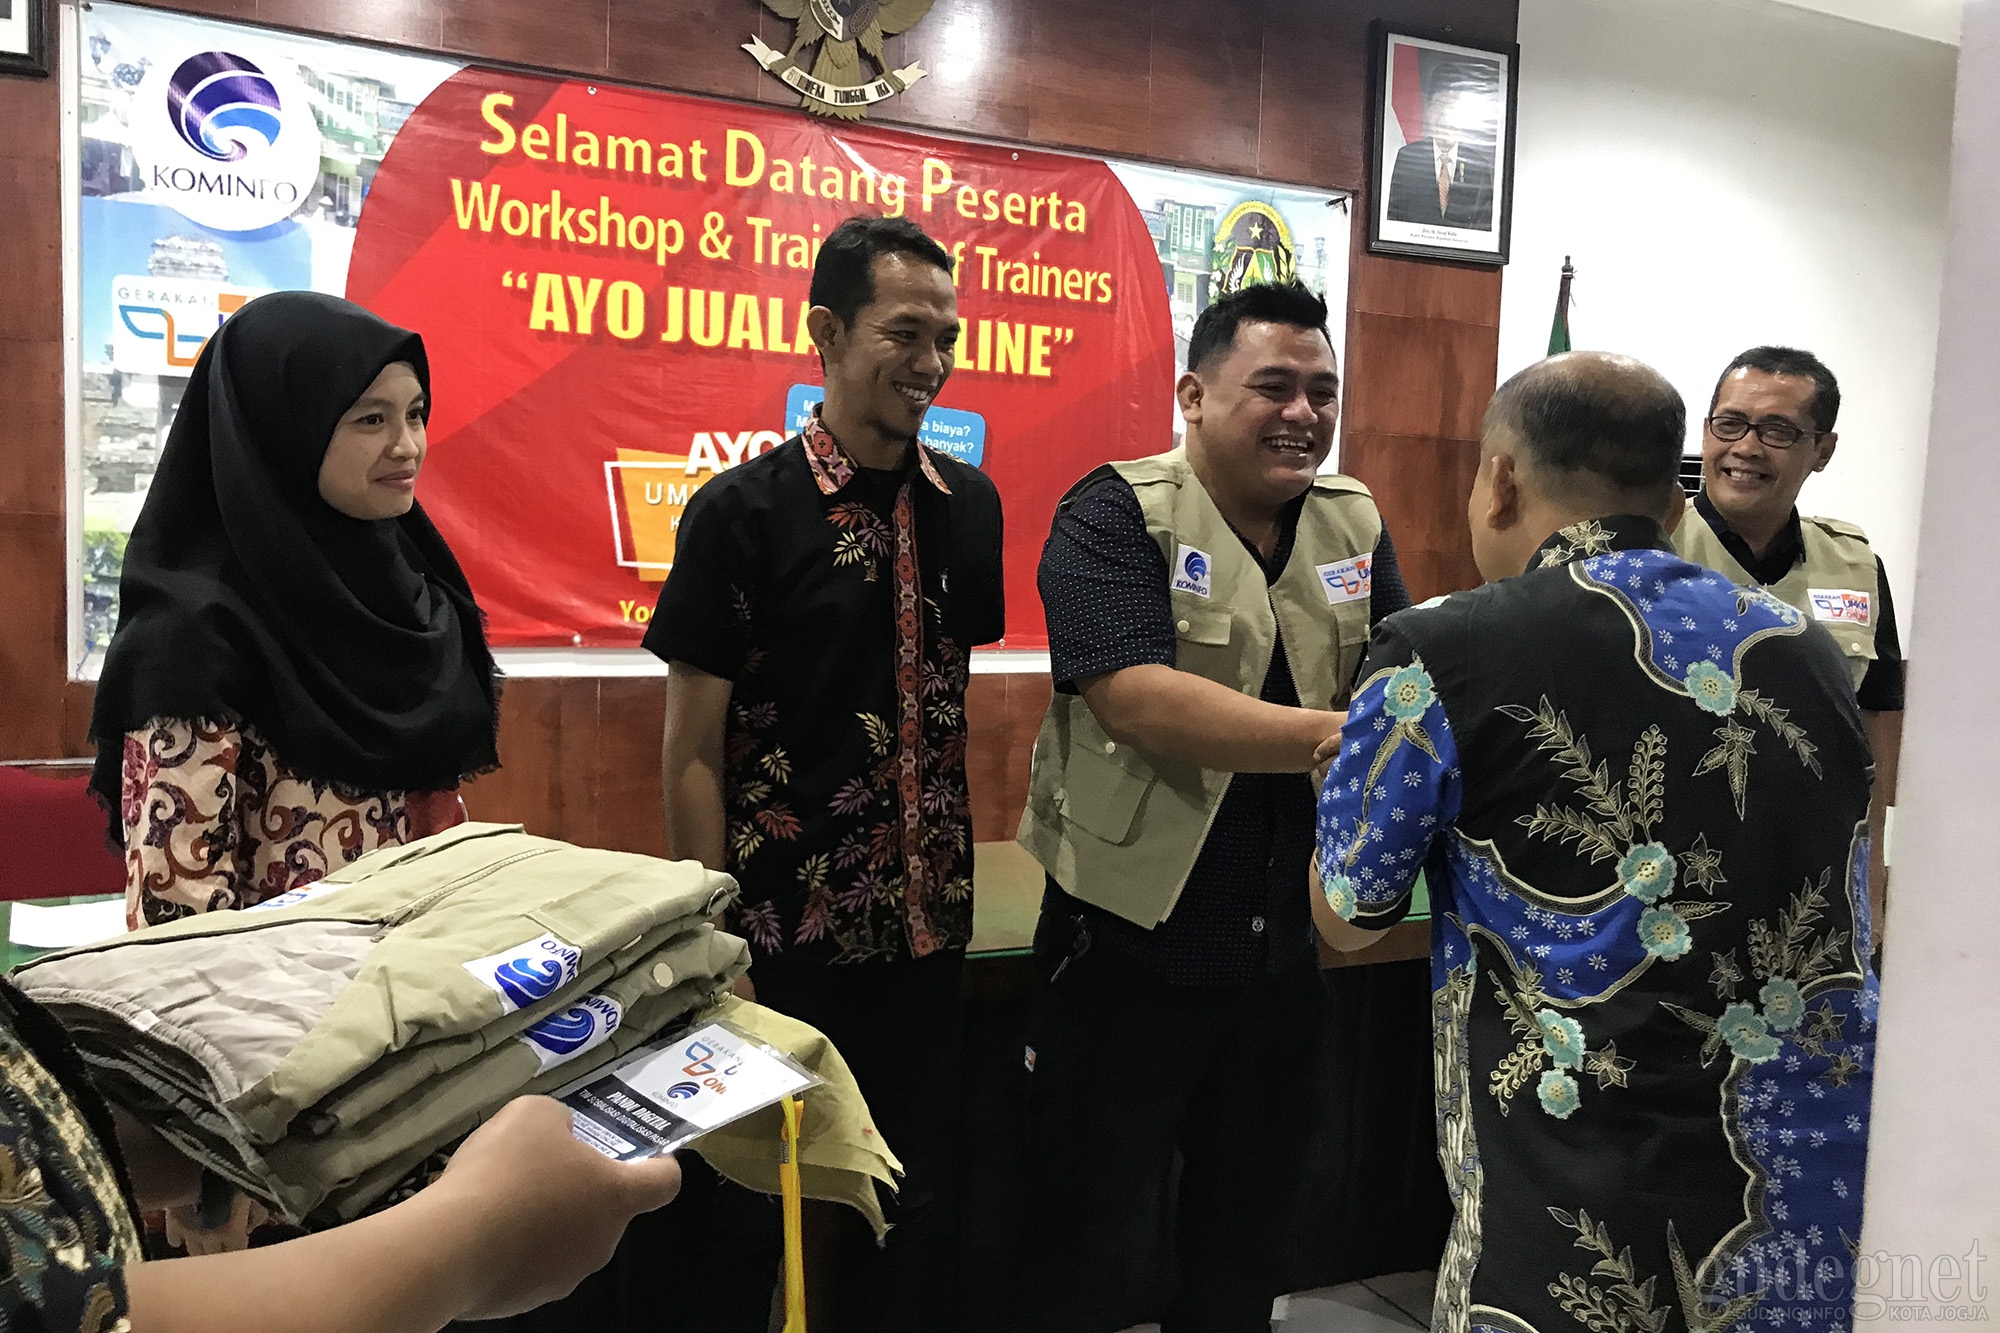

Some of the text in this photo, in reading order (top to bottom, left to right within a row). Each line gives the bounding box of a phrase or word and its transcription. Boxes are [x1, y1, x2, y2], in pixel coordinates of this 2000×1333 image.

[480, 92, 1087, 233] Selamat Datang Peserta
[450, 178, 685, 266] Workshop
[699, 211, 733, 260] &
[746, 216, 822, 270] Trai
[976, 246, 1112, 303] Trainers
[661, 286, 820, 355] JUALA
[954, 316, 1074, 377] LINE”
[925, 435, 974, 453] banyak?
[932, 420, 971, 438] biaya?
[541, 940, 579, 985] OMINFO
[606, 1091, 672, 1131] PANDU DIGITAL
